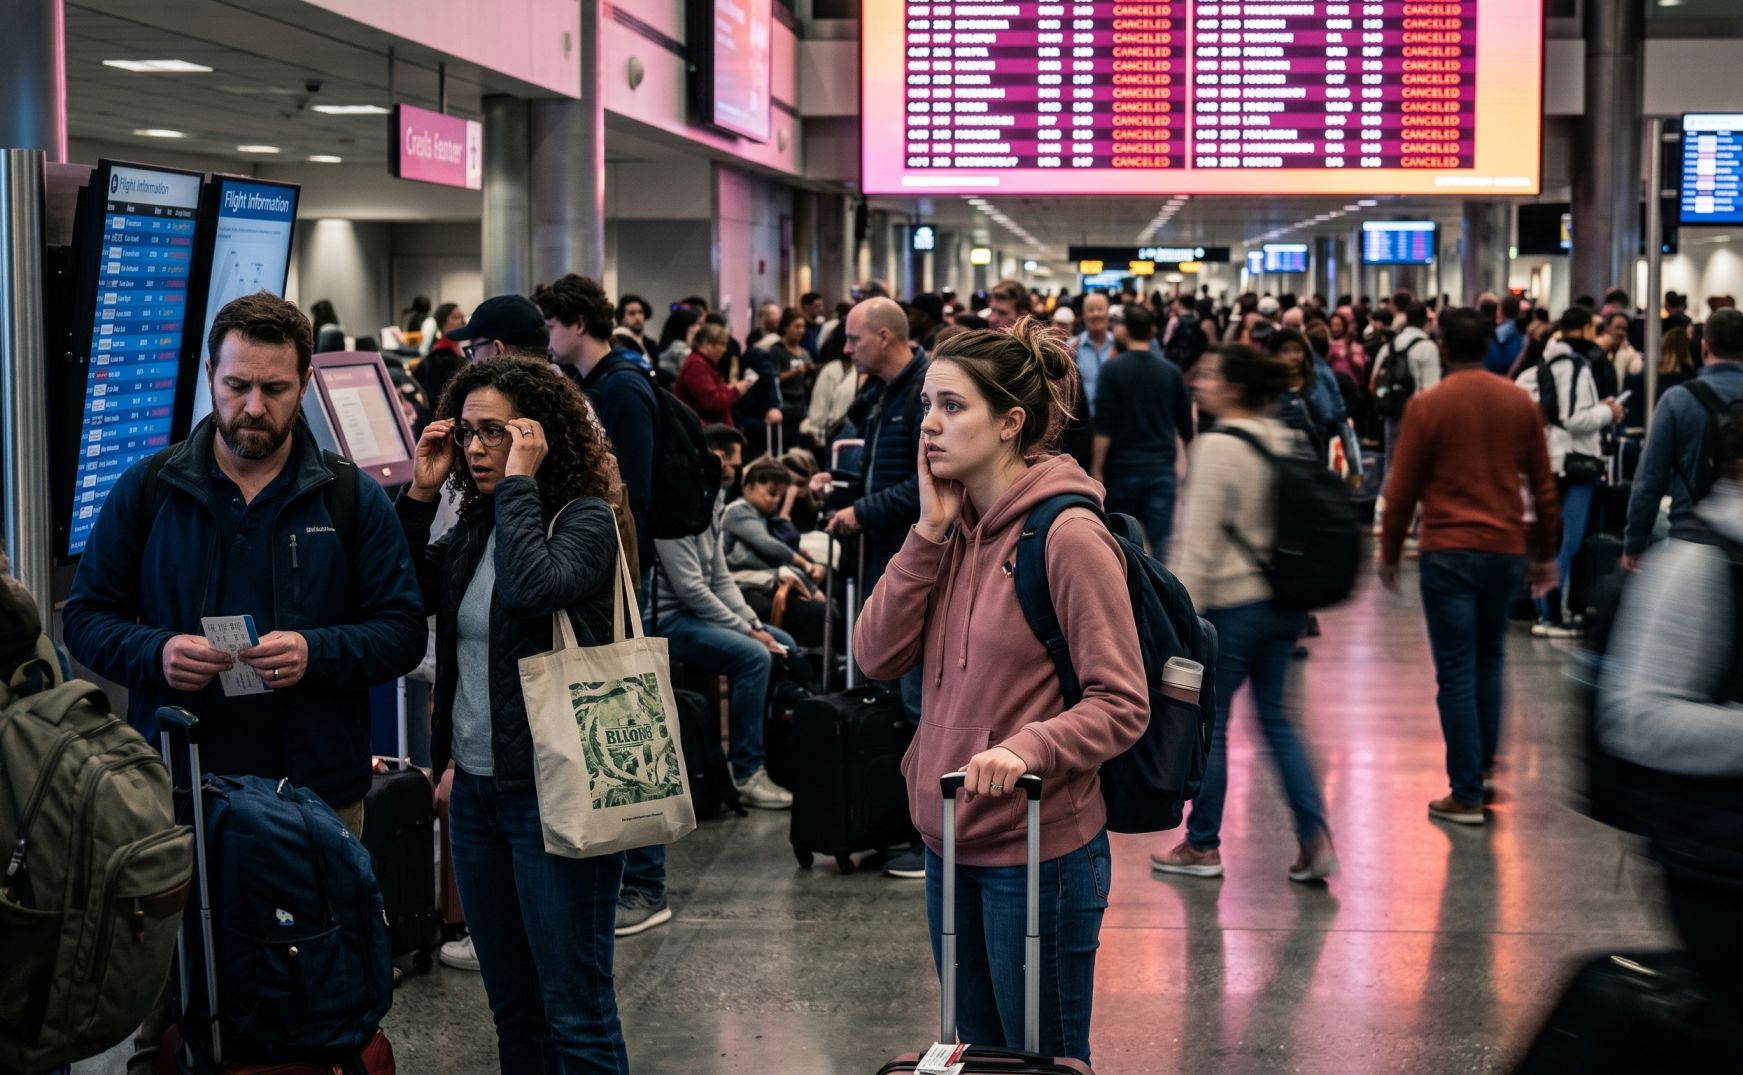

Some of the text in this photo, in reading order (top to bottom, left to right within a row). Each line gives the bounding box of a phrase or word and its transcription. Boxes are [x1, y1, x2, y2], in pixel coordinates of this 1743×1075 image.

[1113, 5, 1171, 16] CANCELED
[1403, 5, 1461, 15] CANCELED
[1113, 19, 1171, 30] CANCELED
[1403, 19, 1461, 29] CANCELED
[1113, 33, 1171, 43] CANCELED
[1403, 33, 1461, 43] CANCELED
[1113, 47, 1171, 57] CANCELED
[1402, 46, 1460, 57] CANCELED
[1112, 61, 1171, 71] CANCELED
[1402, 60, 1460, 70] CANCELED
[1112, 74, 1171, 85] CANCELED
[1402, 74, 1460, 84] CANCELED
[1112, 88, 1171, 98] CANCELED
[1402, 88, 1460, 98] CANCELED
[1112, 102, 1170, 112] CANCELED
[1401, 102, 1460, 112] CANCELED
[1112, 116, 1170, 126] CANCELED
[1401, 116, 1460, 126] CANCELED
[1112, 130, 1170, 140] CANCELED
[1401, 130, 1459, 140] CANCELED
[1112, 143, 1170, 153] CANCELED
[1401, 143, 1459, 153] CANCELED
[1112, 157, 1170, 167] CANCELED
[1401, 157, 1459, 167] CANCELED
[119, 176, 136, 194] Flight
[224, 190, 289, 213] Flight Information
